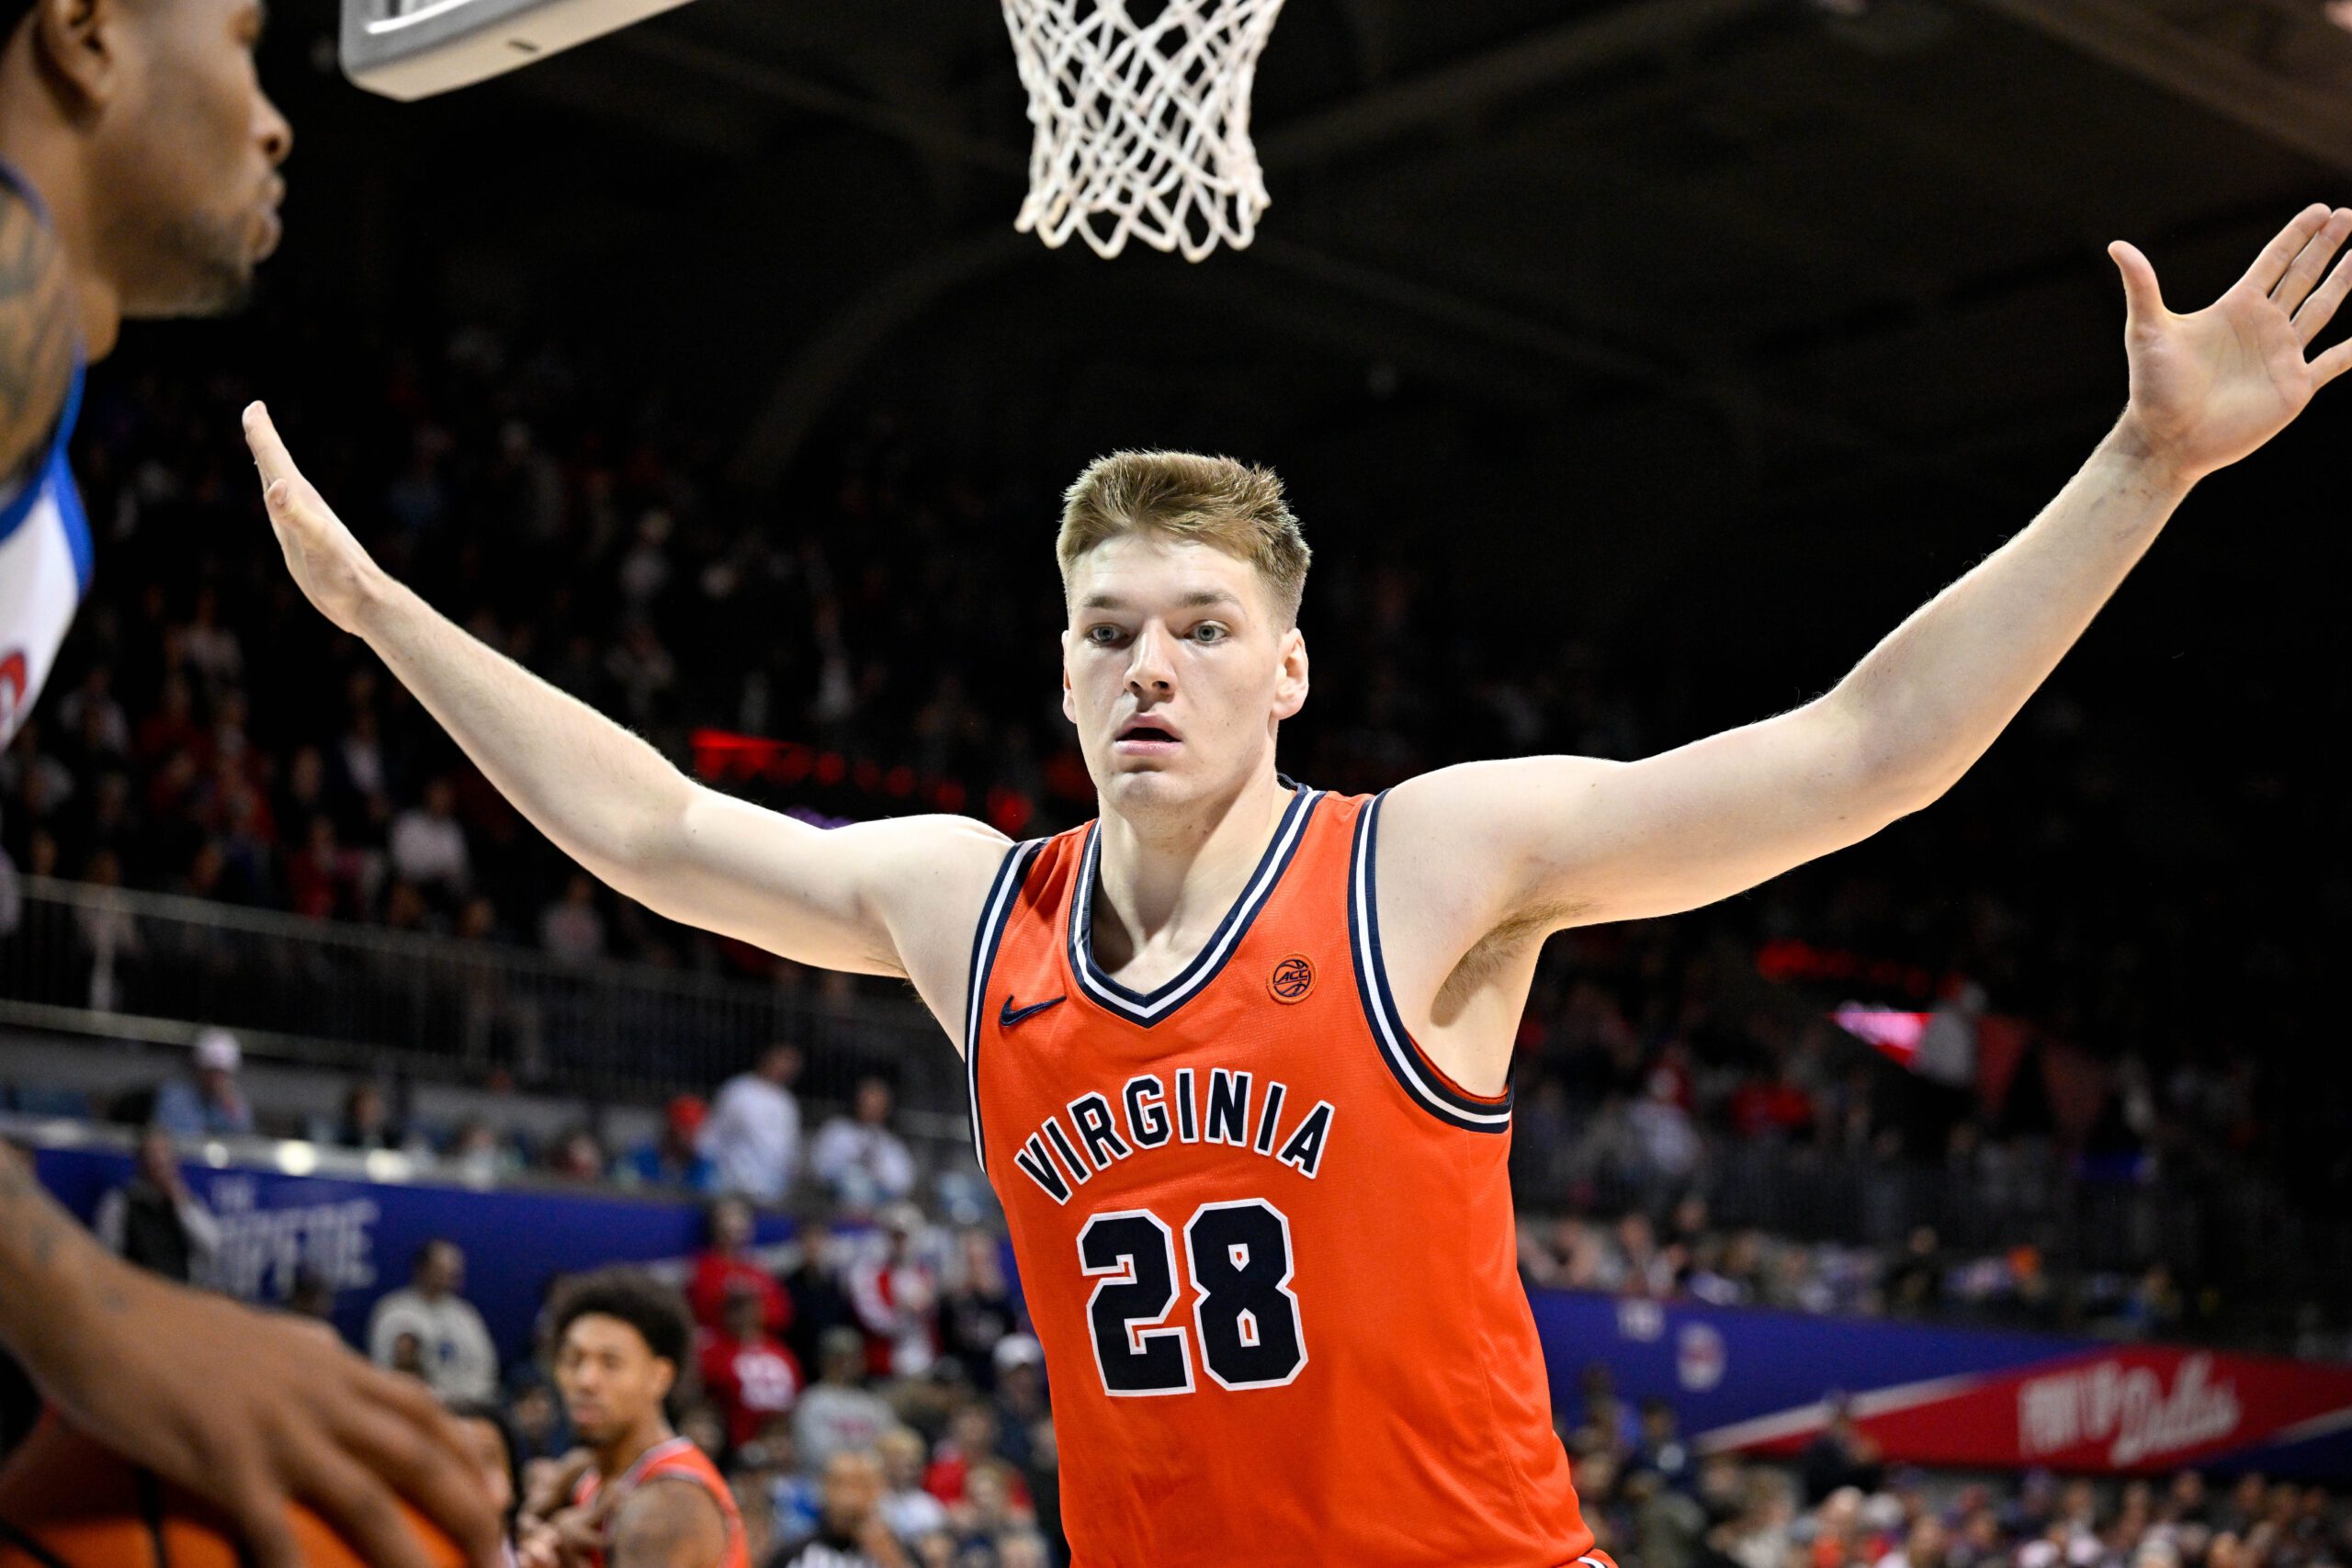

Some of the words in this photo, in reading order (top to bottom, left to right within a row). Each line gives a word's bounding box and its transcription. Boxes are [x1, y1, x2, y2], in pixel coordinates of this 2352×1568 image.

[1275, 968, 1309, 984] ACC
[1014, 1067, 1335, 1205] VIRGINIA
[1076, 1198, 1309, 1397] 28
